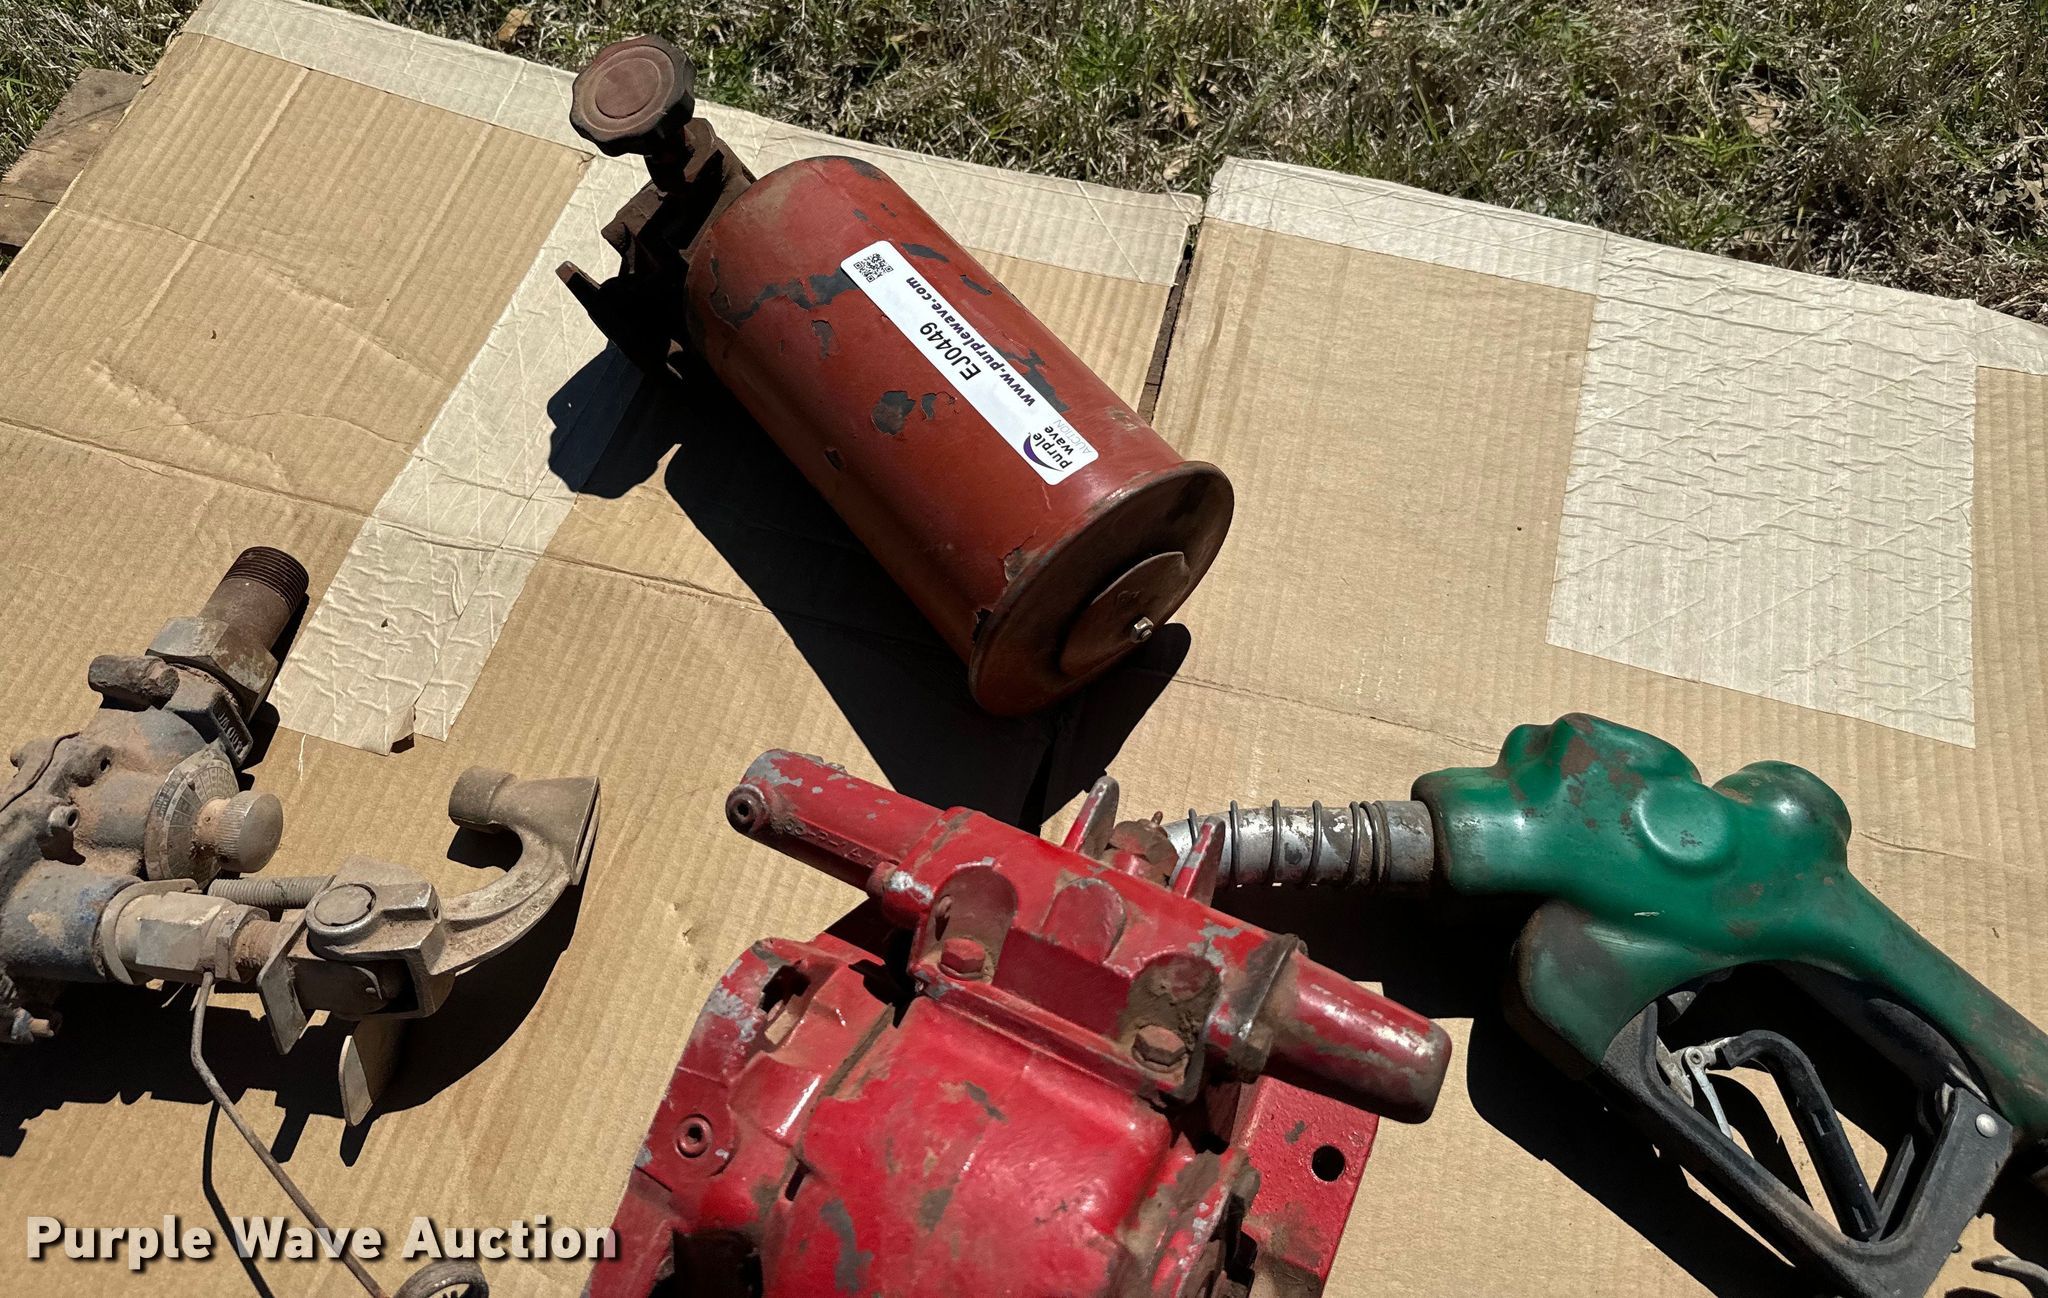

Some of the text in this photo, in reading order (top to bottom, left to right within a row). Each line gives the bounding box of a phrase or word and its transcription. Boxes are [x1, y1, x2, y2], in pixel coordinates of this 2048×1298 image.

[906, 277, 1036, 406] www.purplewave.com
[920, 322, 980, 381] EJ0449
[1032, 432, 1073, 469] purple
[1043, 426, 1075, 455] wave
[1053, 419, 1092, 454] AUCTION
